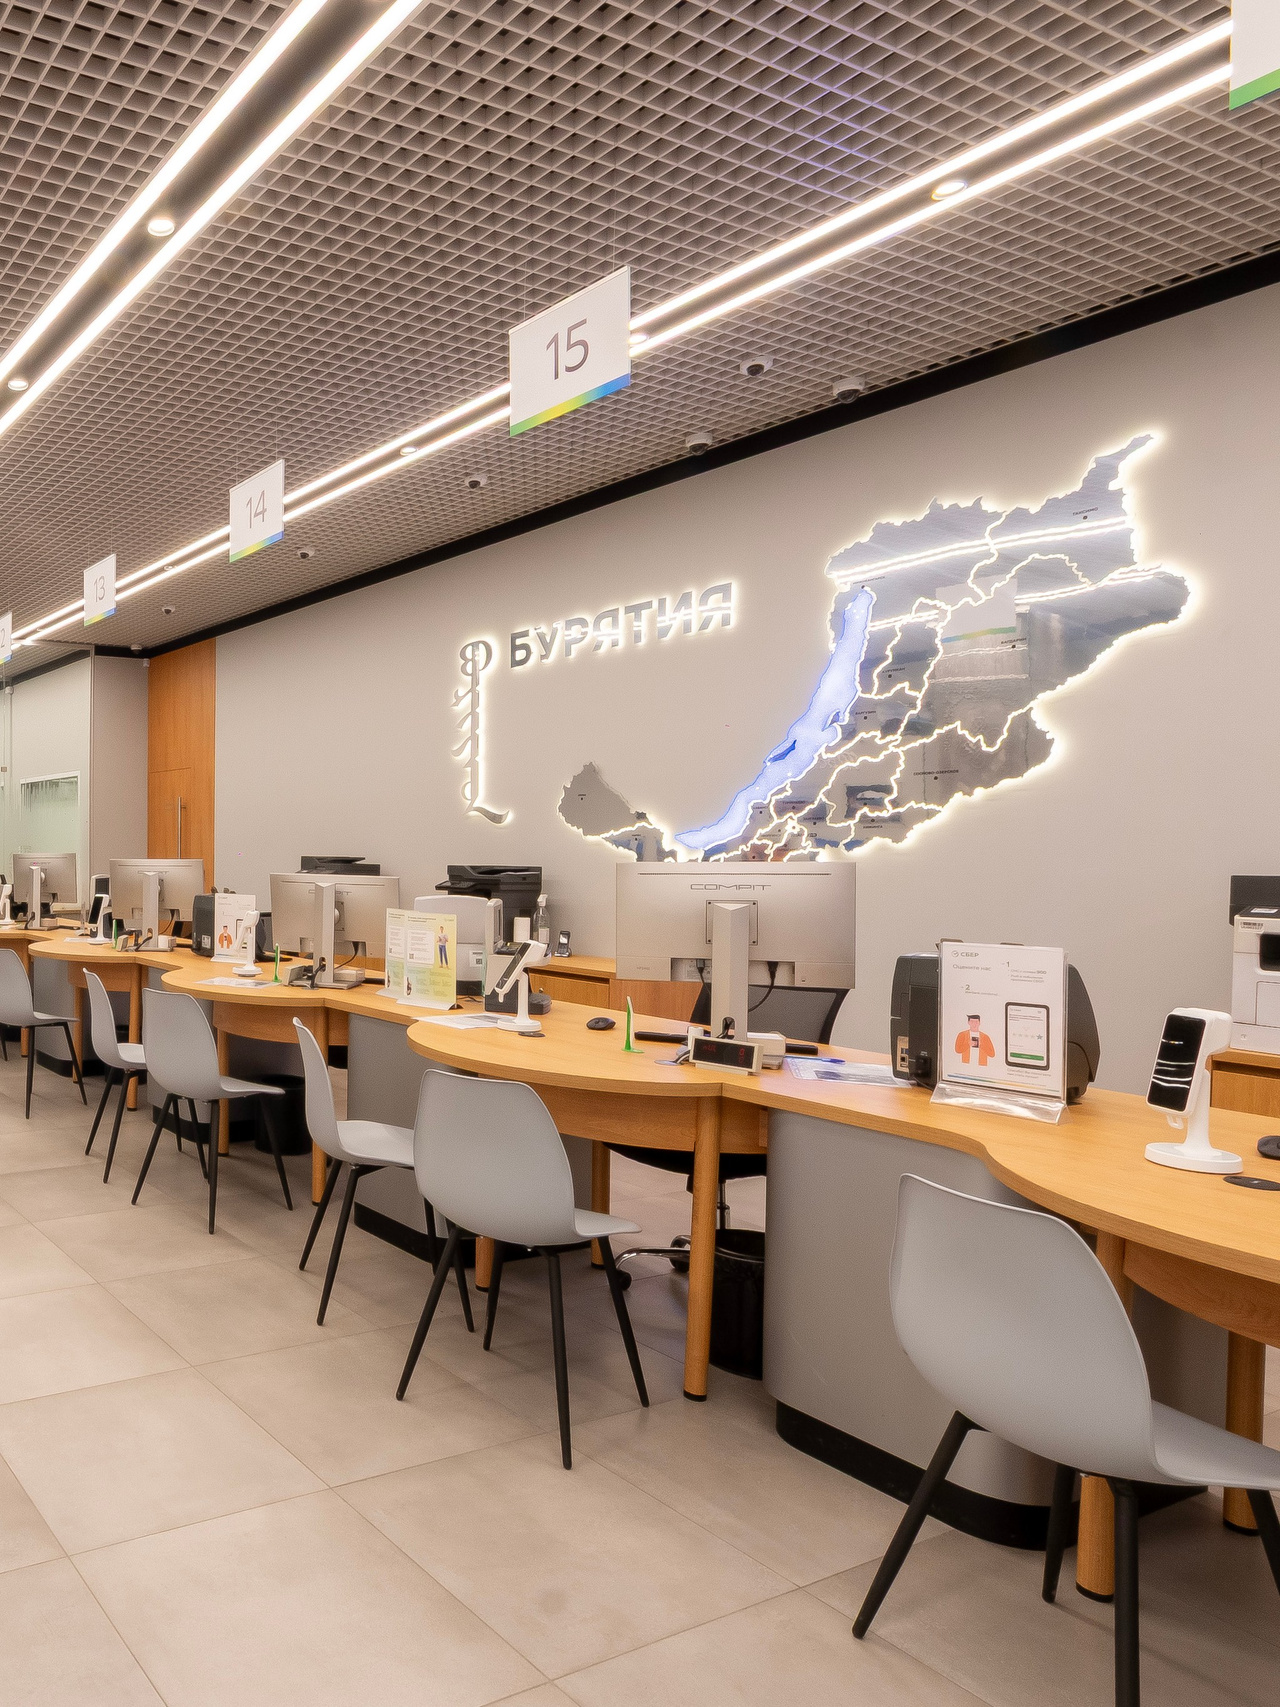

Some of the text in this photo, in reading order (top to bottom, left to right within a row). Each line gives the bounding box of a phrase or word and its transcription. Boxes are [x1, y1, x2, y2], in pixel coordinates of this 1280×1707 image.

[546, 318, 589, 380] 15
[245, 490, 267, 529] 14
[93, 575, 106, 603] 13
[510, 582, 732, 668] БУРЯТИЯ
[690, 883, 772, 891] COMPIT
[952, 963, 980, 971] Оцените
